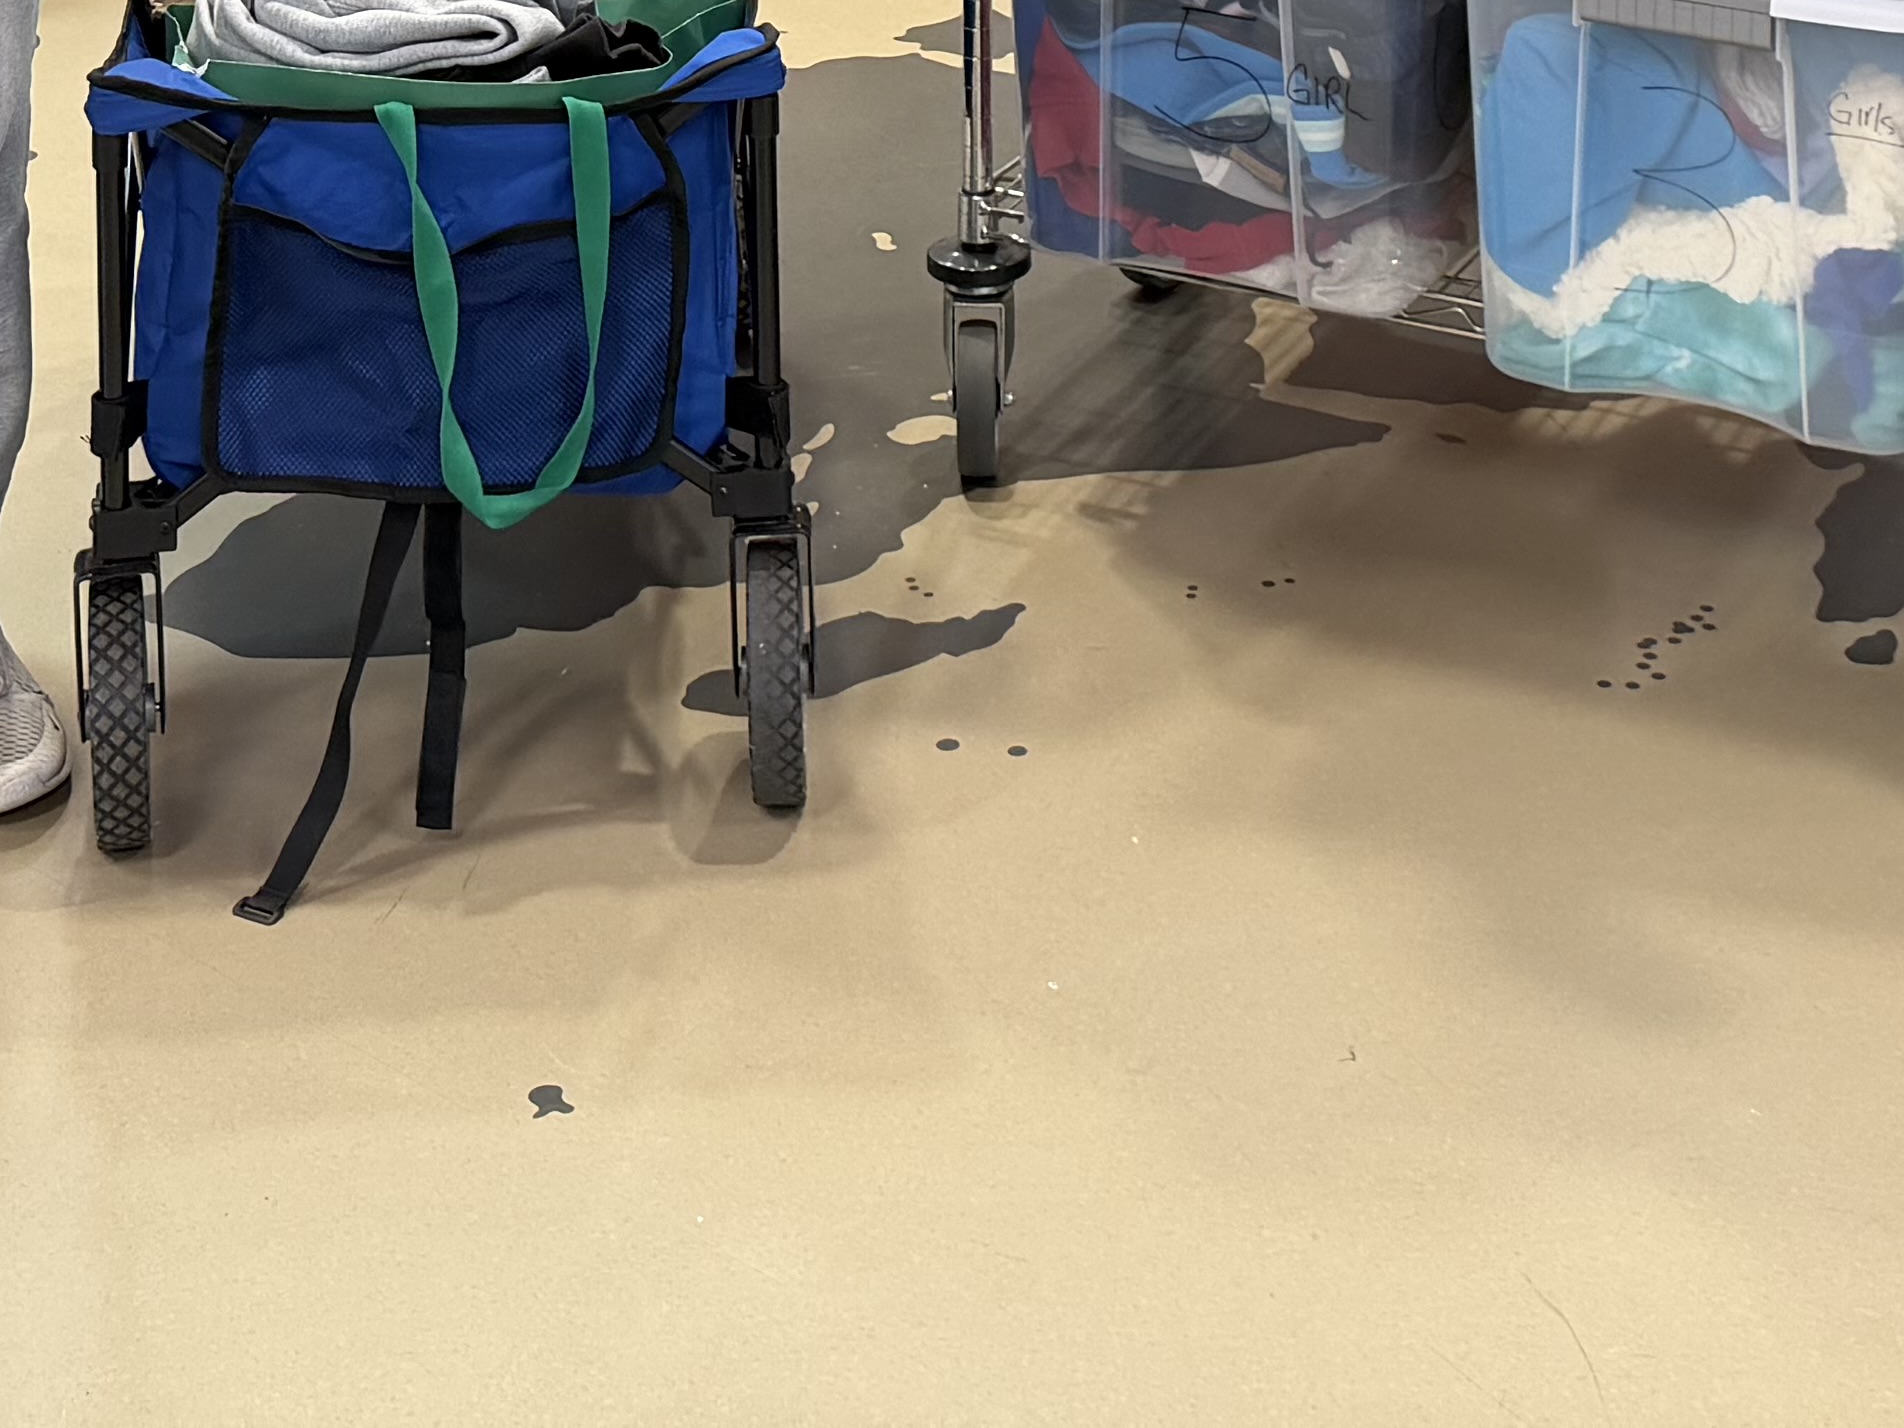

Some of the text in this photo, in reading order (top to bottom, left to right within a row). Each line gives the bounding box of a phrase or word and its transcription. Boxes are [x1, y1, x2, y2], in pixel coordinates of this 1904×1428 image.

[1153, 5, 1273, 145] 5
[1285, 62, 1373, 123] GIRL
[1826, 90, 1897, 136] Girls
